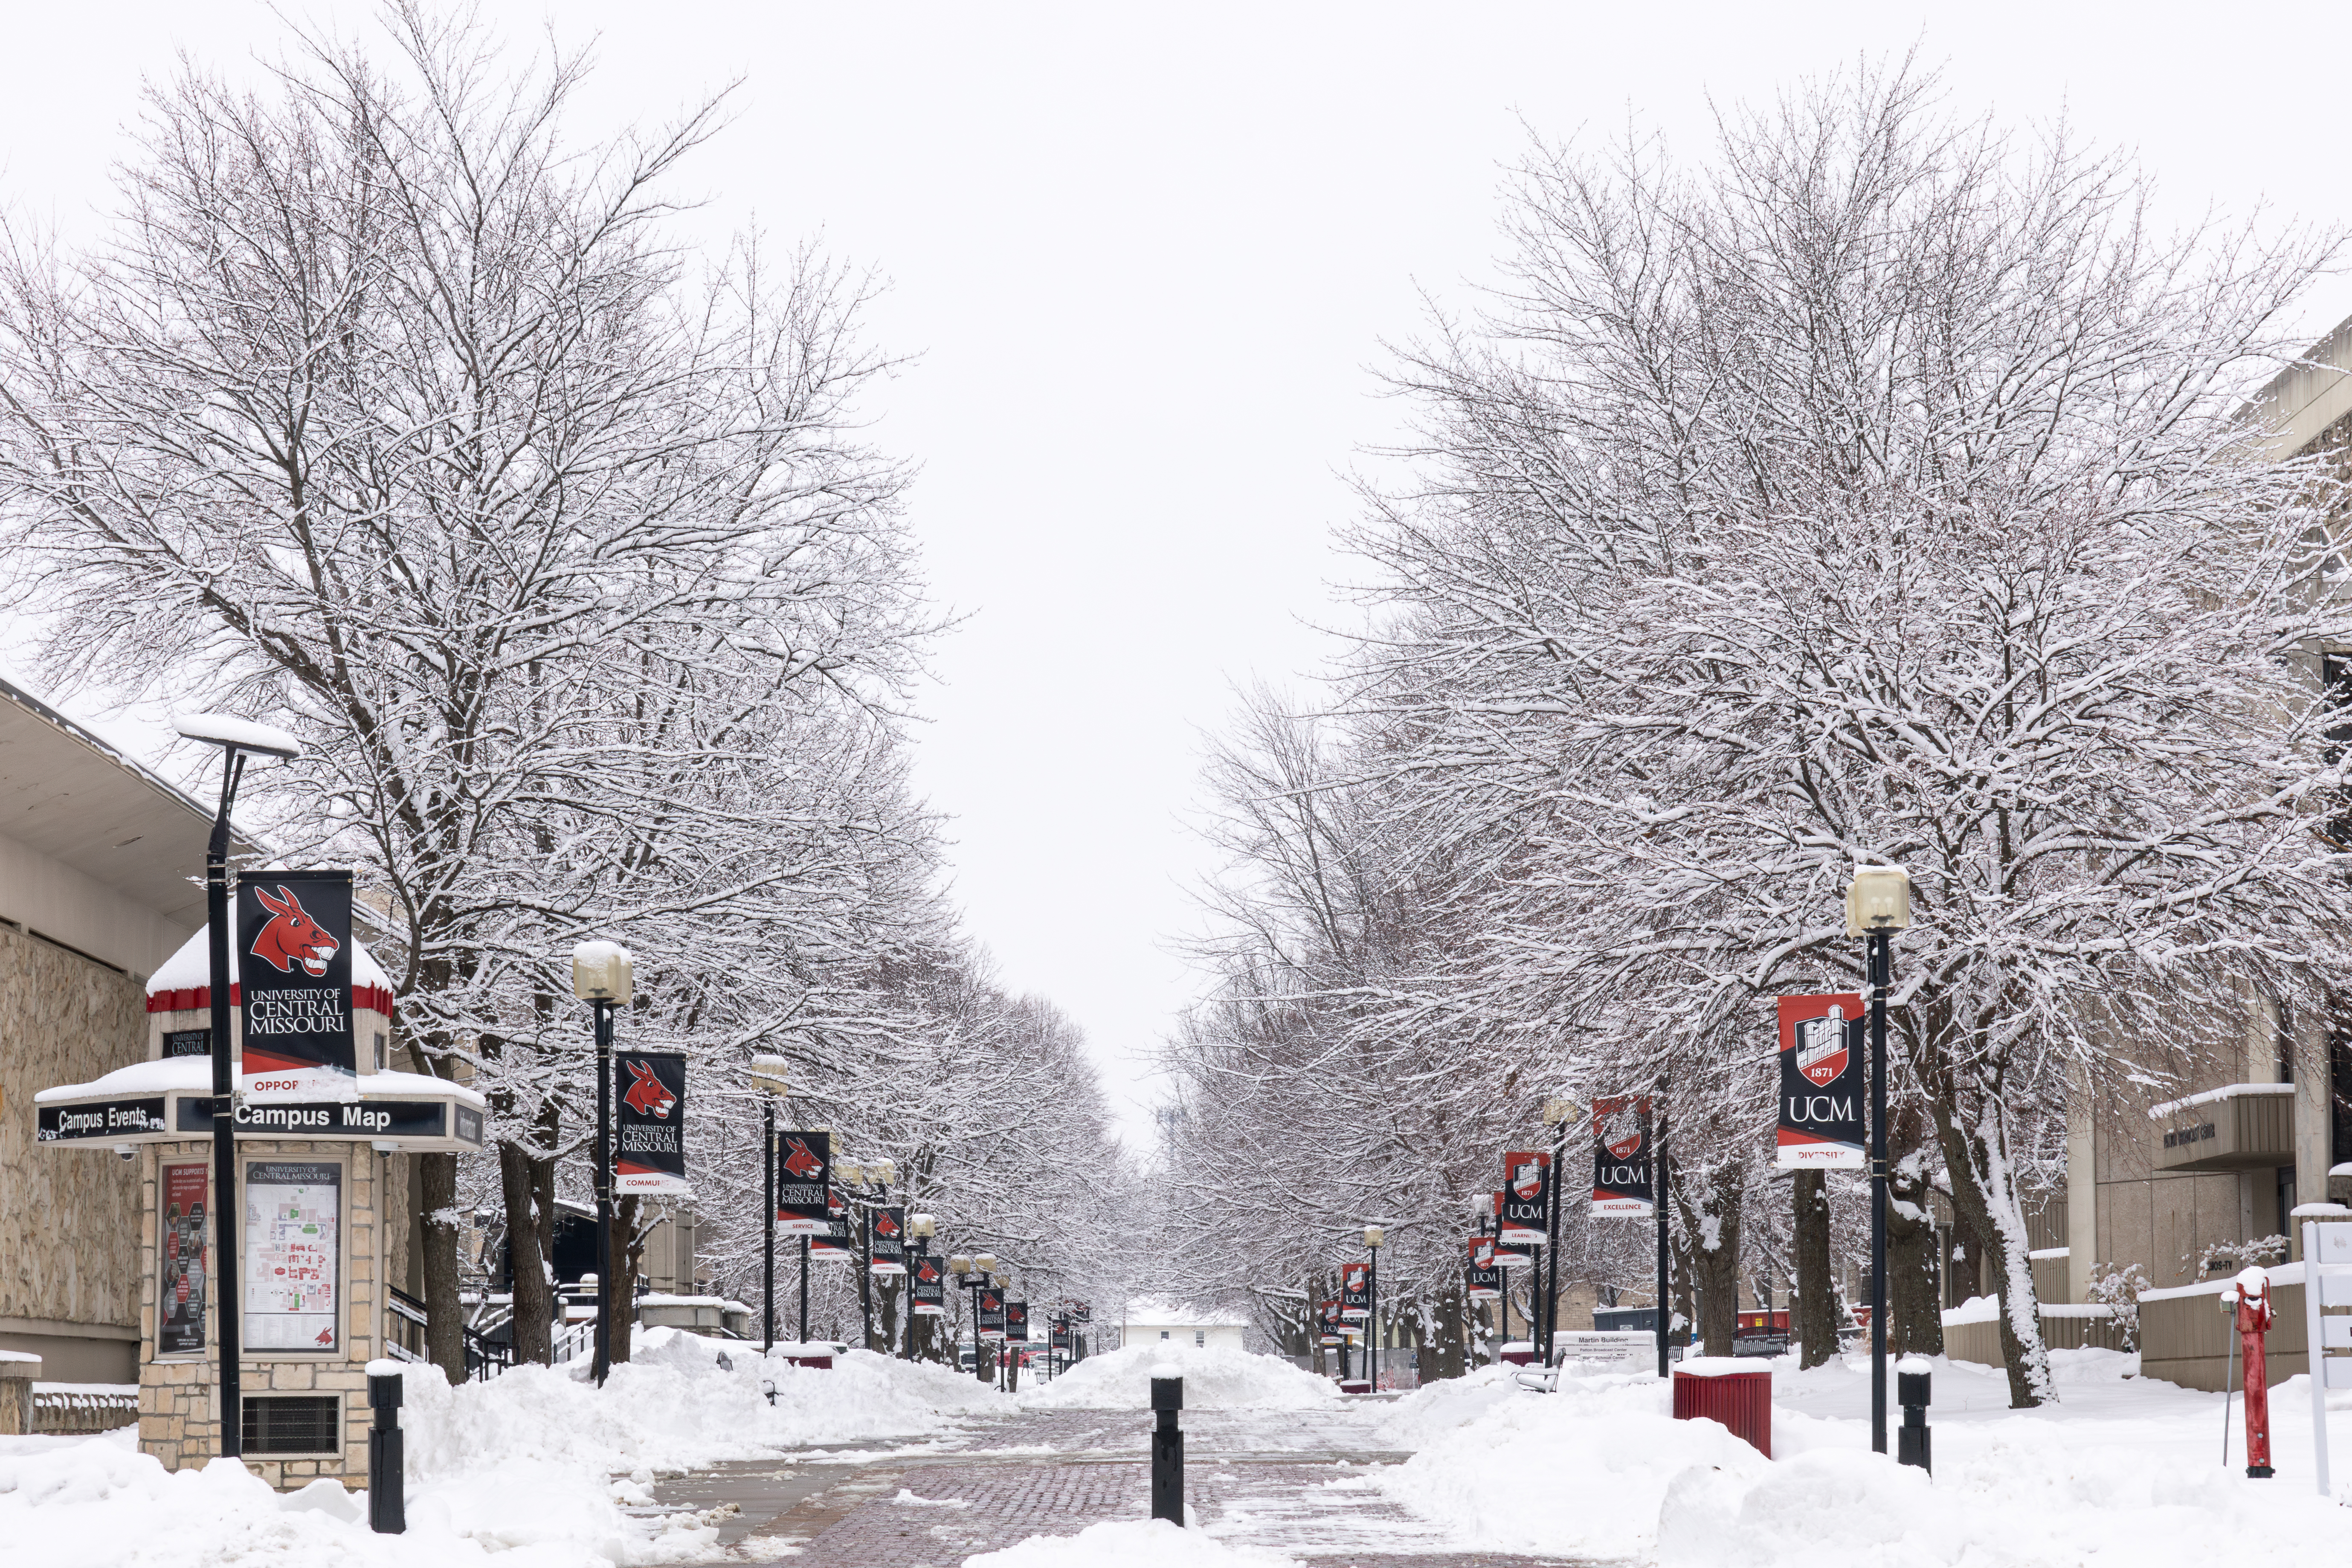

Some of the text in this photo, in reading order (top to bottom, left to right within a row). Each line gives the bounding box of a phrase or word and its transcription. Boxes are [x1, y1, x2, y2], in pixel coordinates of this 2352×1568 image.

[251, 988, 340, 1001] UNIVERSITY OF
[250, 1000, 344, 1020] CENTRAL
[249, 1017, 345, 1034] MISSOURI
[173, 1033, 198, 1042] UNIVERSITY
[172, 1041, 204, 1055] CENTRAL
[1811, 1068, 1833, 1077] 1871
[1789, 1096, 1856, 1122] UCM
[59, 1107, 146, 1133] Campus Events
[235, 1104, 390, 1132] Campus Map
[622, 1131, 677, 1143] CENTRAL
[622, 1142, 678, 1153] MISSOURI
[1601, 1166, 1647, 1184] UCM
[782, 1189, 824, 1197] CENTRAL
[1510, 1204, 1543, 1219] UCM
[2208, 1260, 2233, 1270] MOS-TV
[1473, 1272, 1496, 1282] UCM
[1346, 1295, 1366, 1303] UCM
